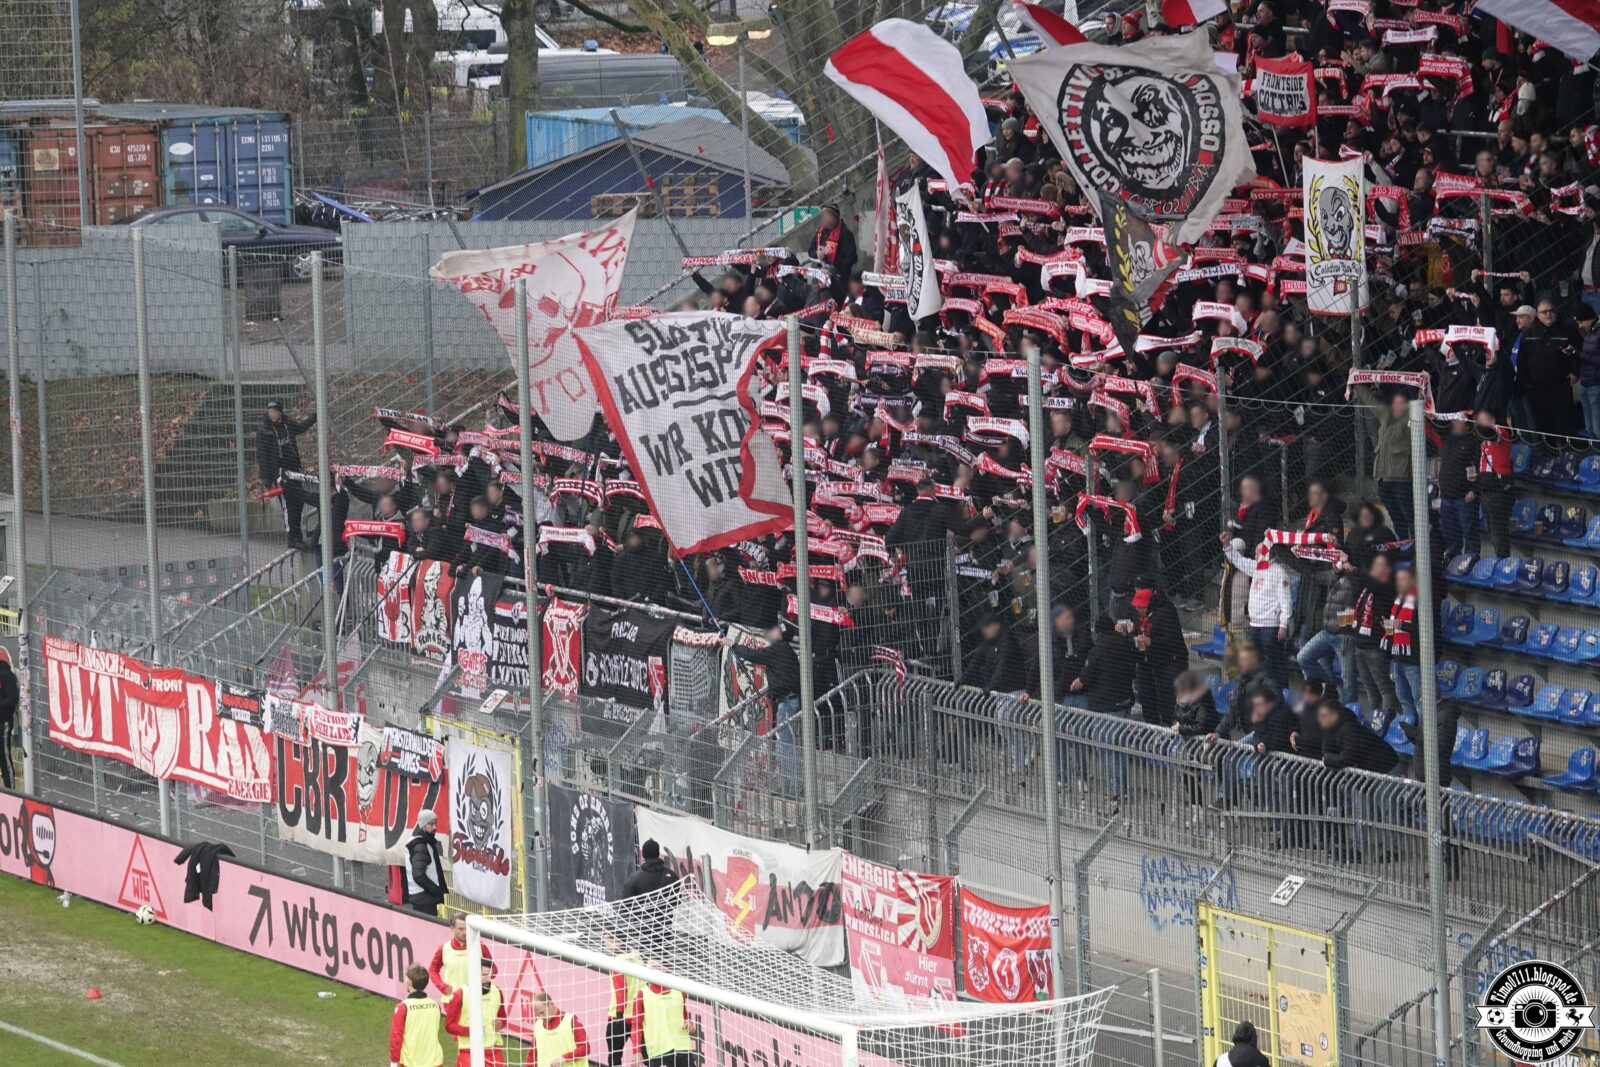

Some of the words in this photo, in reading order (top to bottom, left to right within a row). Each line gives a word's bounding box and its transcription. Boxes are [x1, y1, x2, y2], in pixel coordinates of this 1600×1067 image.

[1261, 72, 1304, 92] FRONTSIDE
[691, 407, 751, 455] KO
[151, 678, 183, 693] FRONT
[397, 748, 421, 775] JUNGS
[227, 778, 271, 802] ENERGIE
[132, 868, 151, 901] WTG
[842, 854, 897, 893] ENERGIE
[575, 878, 607, 901] COTTBUS
[1274, 879, 1299, 901] 25
[283, 896, 414, 983] wtg.com
[918, 955, 938, 973] Hier
